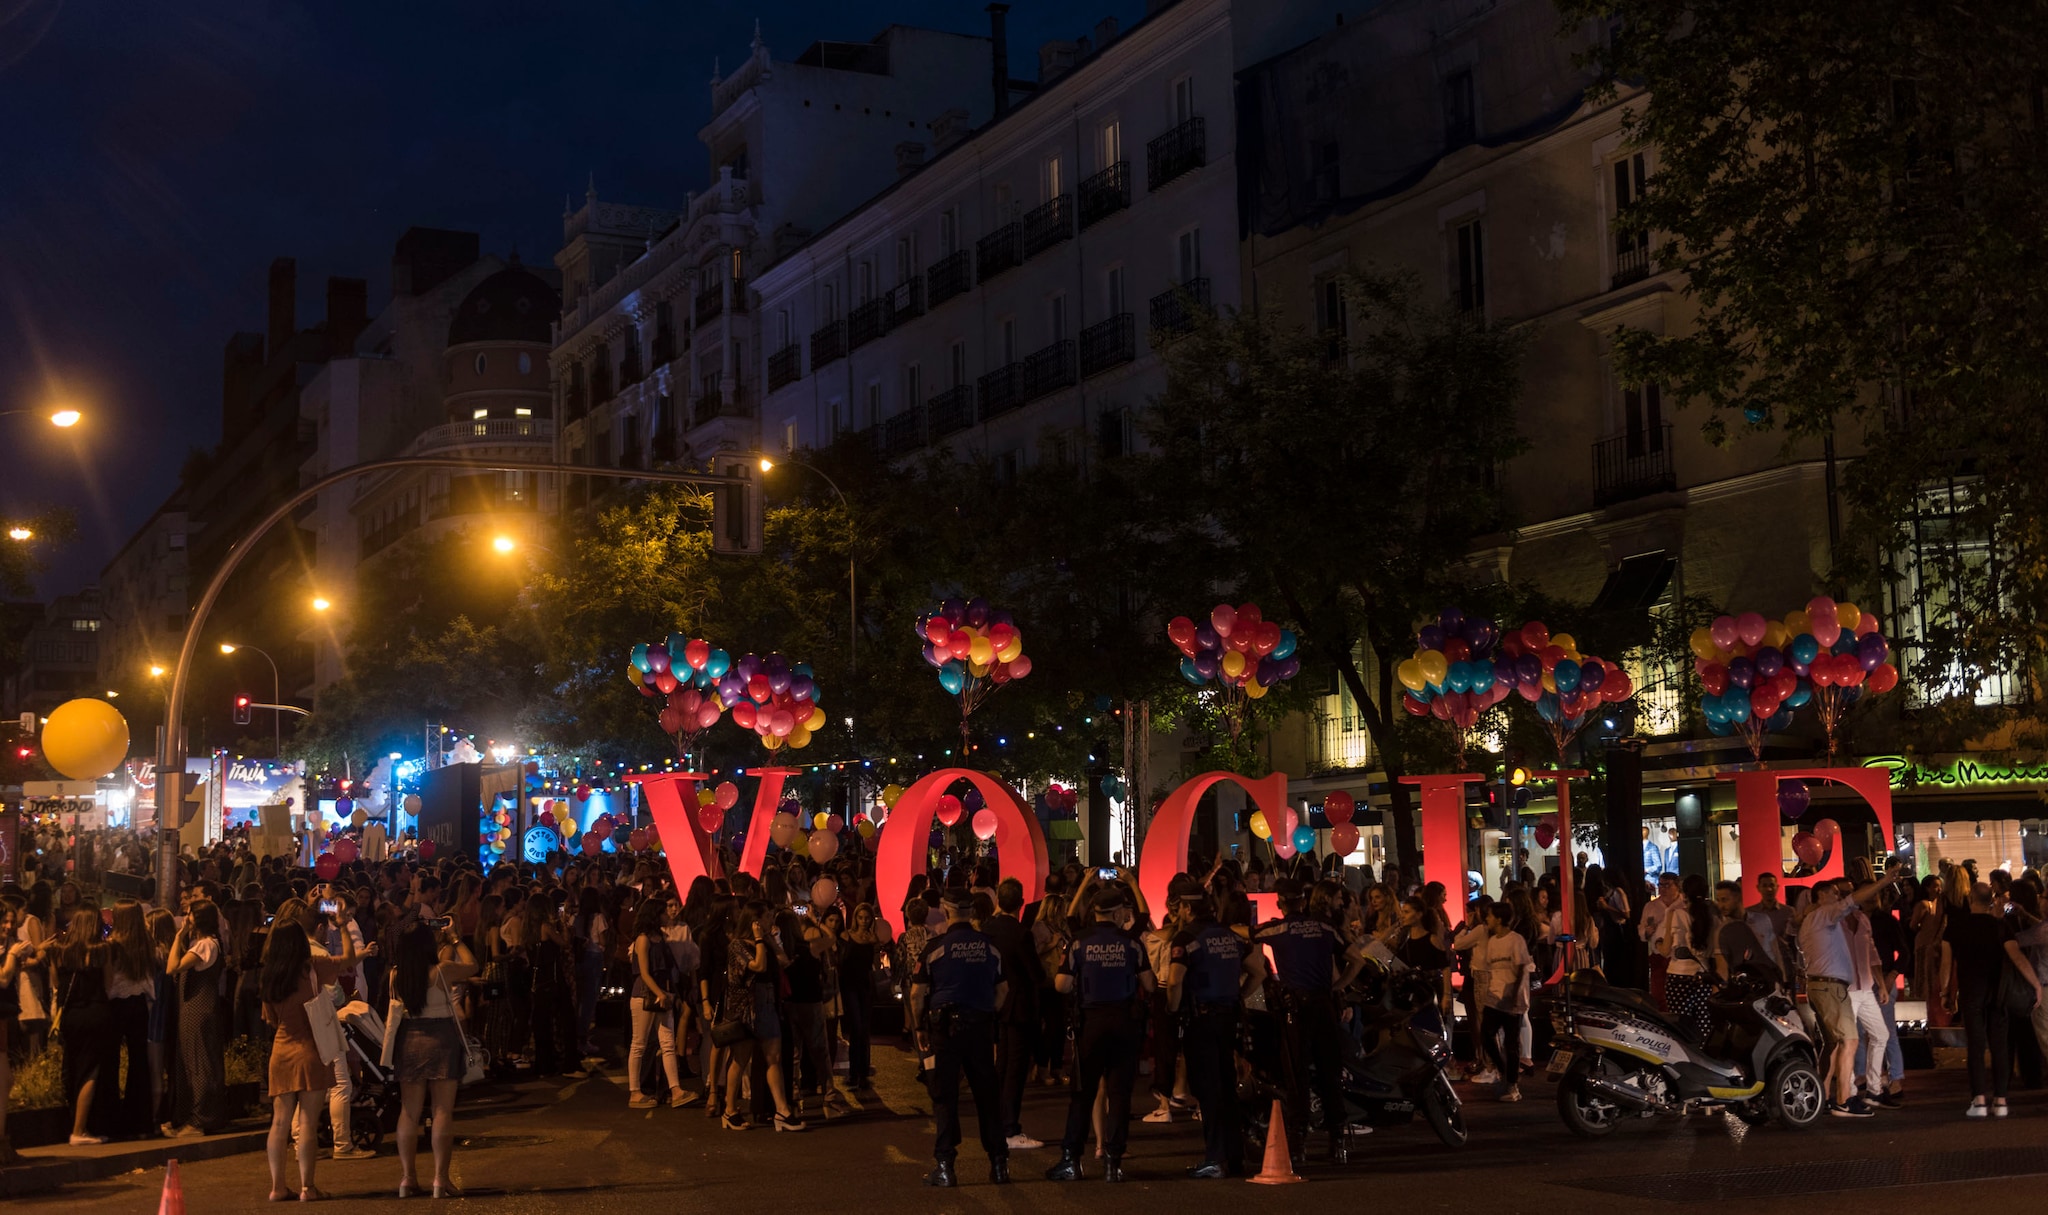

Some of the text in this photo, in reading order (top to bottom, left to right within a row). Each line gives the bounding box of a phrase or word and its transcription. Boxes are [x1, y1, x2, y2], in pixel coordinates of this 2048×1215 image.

[528, 831, 554, 843] TATTOO
[622, 766, 1896, 990] VOGUE
[950, 940, 986, 950] POLICÍA
[1086, 941, 1125, 953] POLICÍA
[951, 949, 987, 959] MUNICIPAL
[1085, 952, 1126, 962] MUNICIPAL
[1101, 960, 1126, 968] Madrid
[1614, 1033, 1626, 1042] 112
